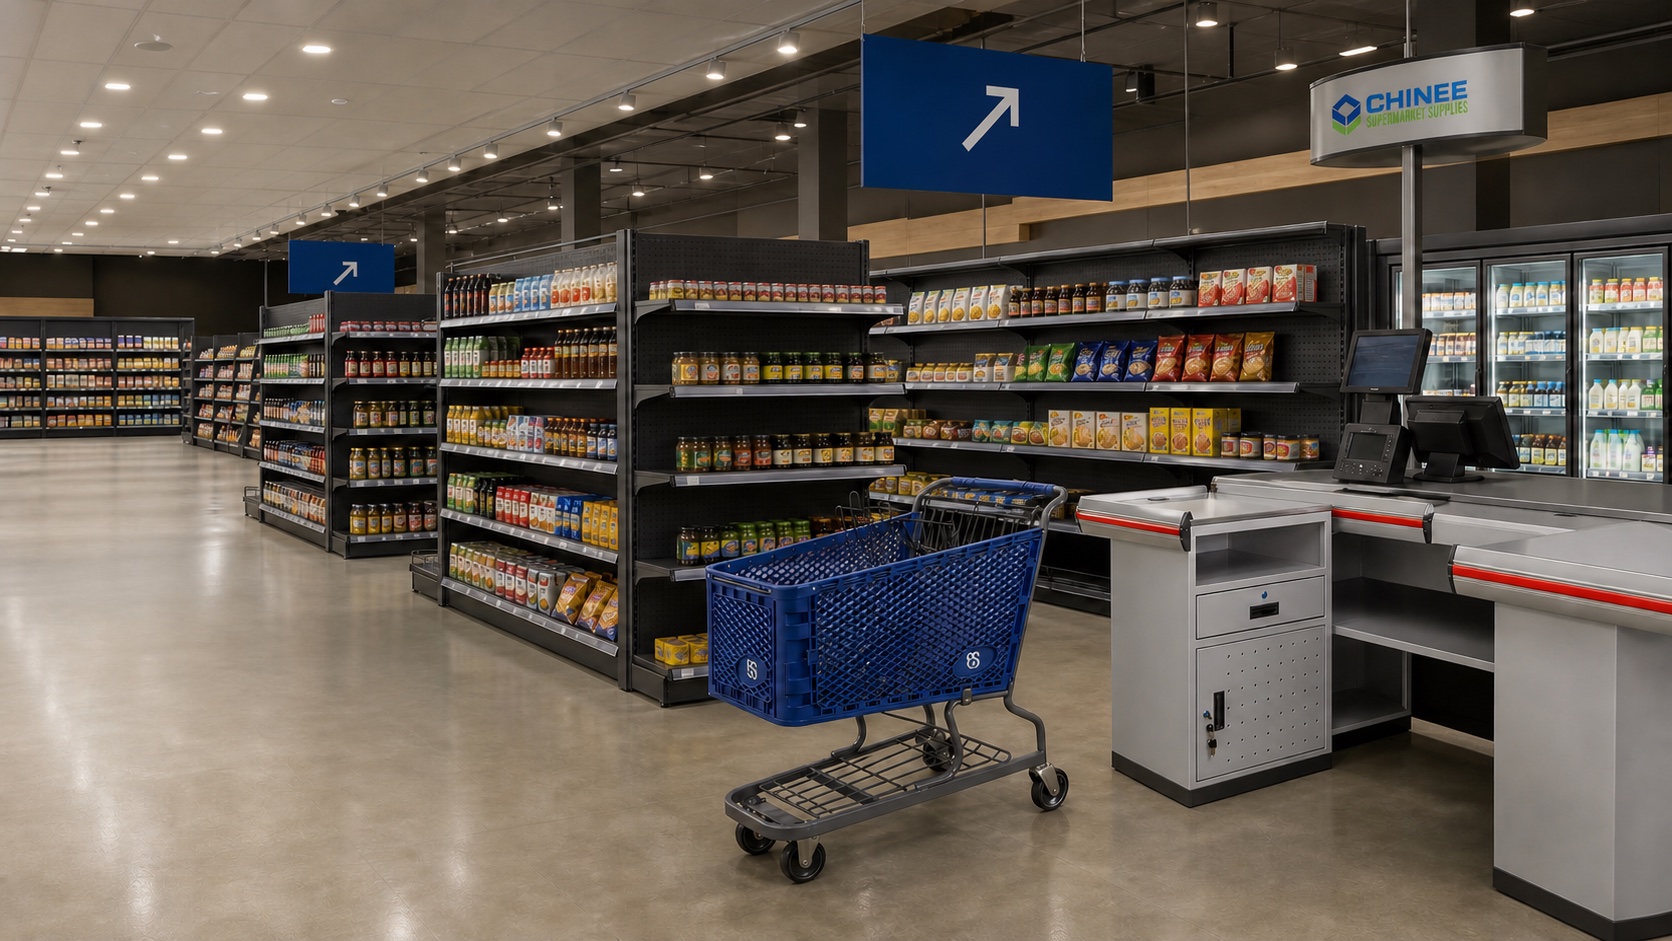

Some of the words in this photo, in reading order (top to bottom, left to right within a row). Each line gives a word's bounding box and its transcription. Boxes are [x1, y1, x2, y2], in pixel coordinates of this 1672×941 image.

[1366, 80, 1467, 114] CHINEE
[1366, 107, 1425, 128] SUPERMARKET
[1427, 100, 1469, 119] SUPPLIES
